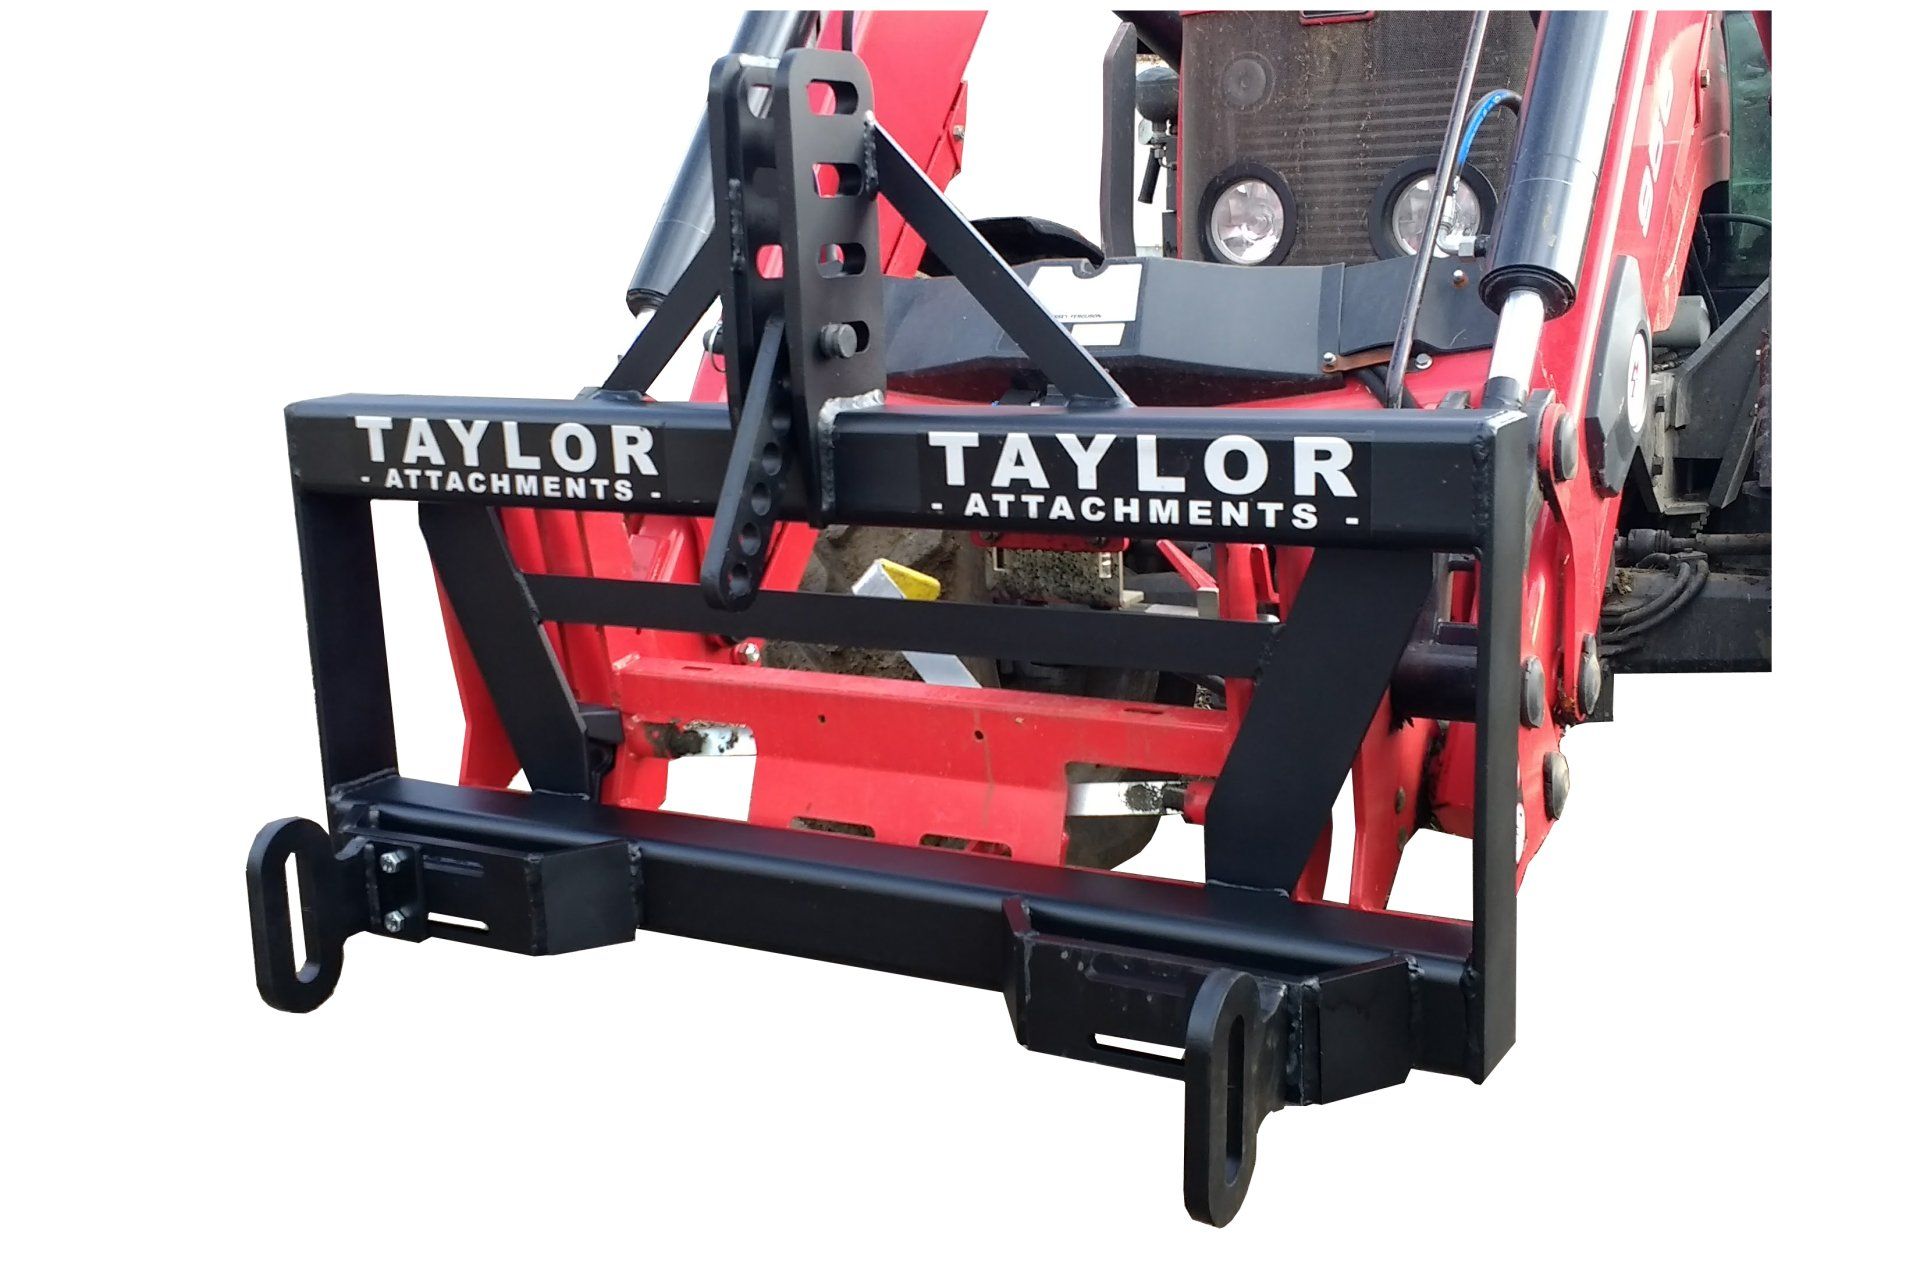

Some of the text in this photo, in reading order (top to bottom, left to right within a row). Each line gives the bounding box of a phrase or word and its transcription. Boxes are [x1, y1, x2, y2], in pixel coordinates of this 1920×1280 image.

[354, 414, 659, 476] TAYLOR
[928, 430, 1358, 498] TAYLOR
[385, 468, 633, 501] ATTACHMENTS
[964, 492, 1318, 530] ATTACHMENTS
